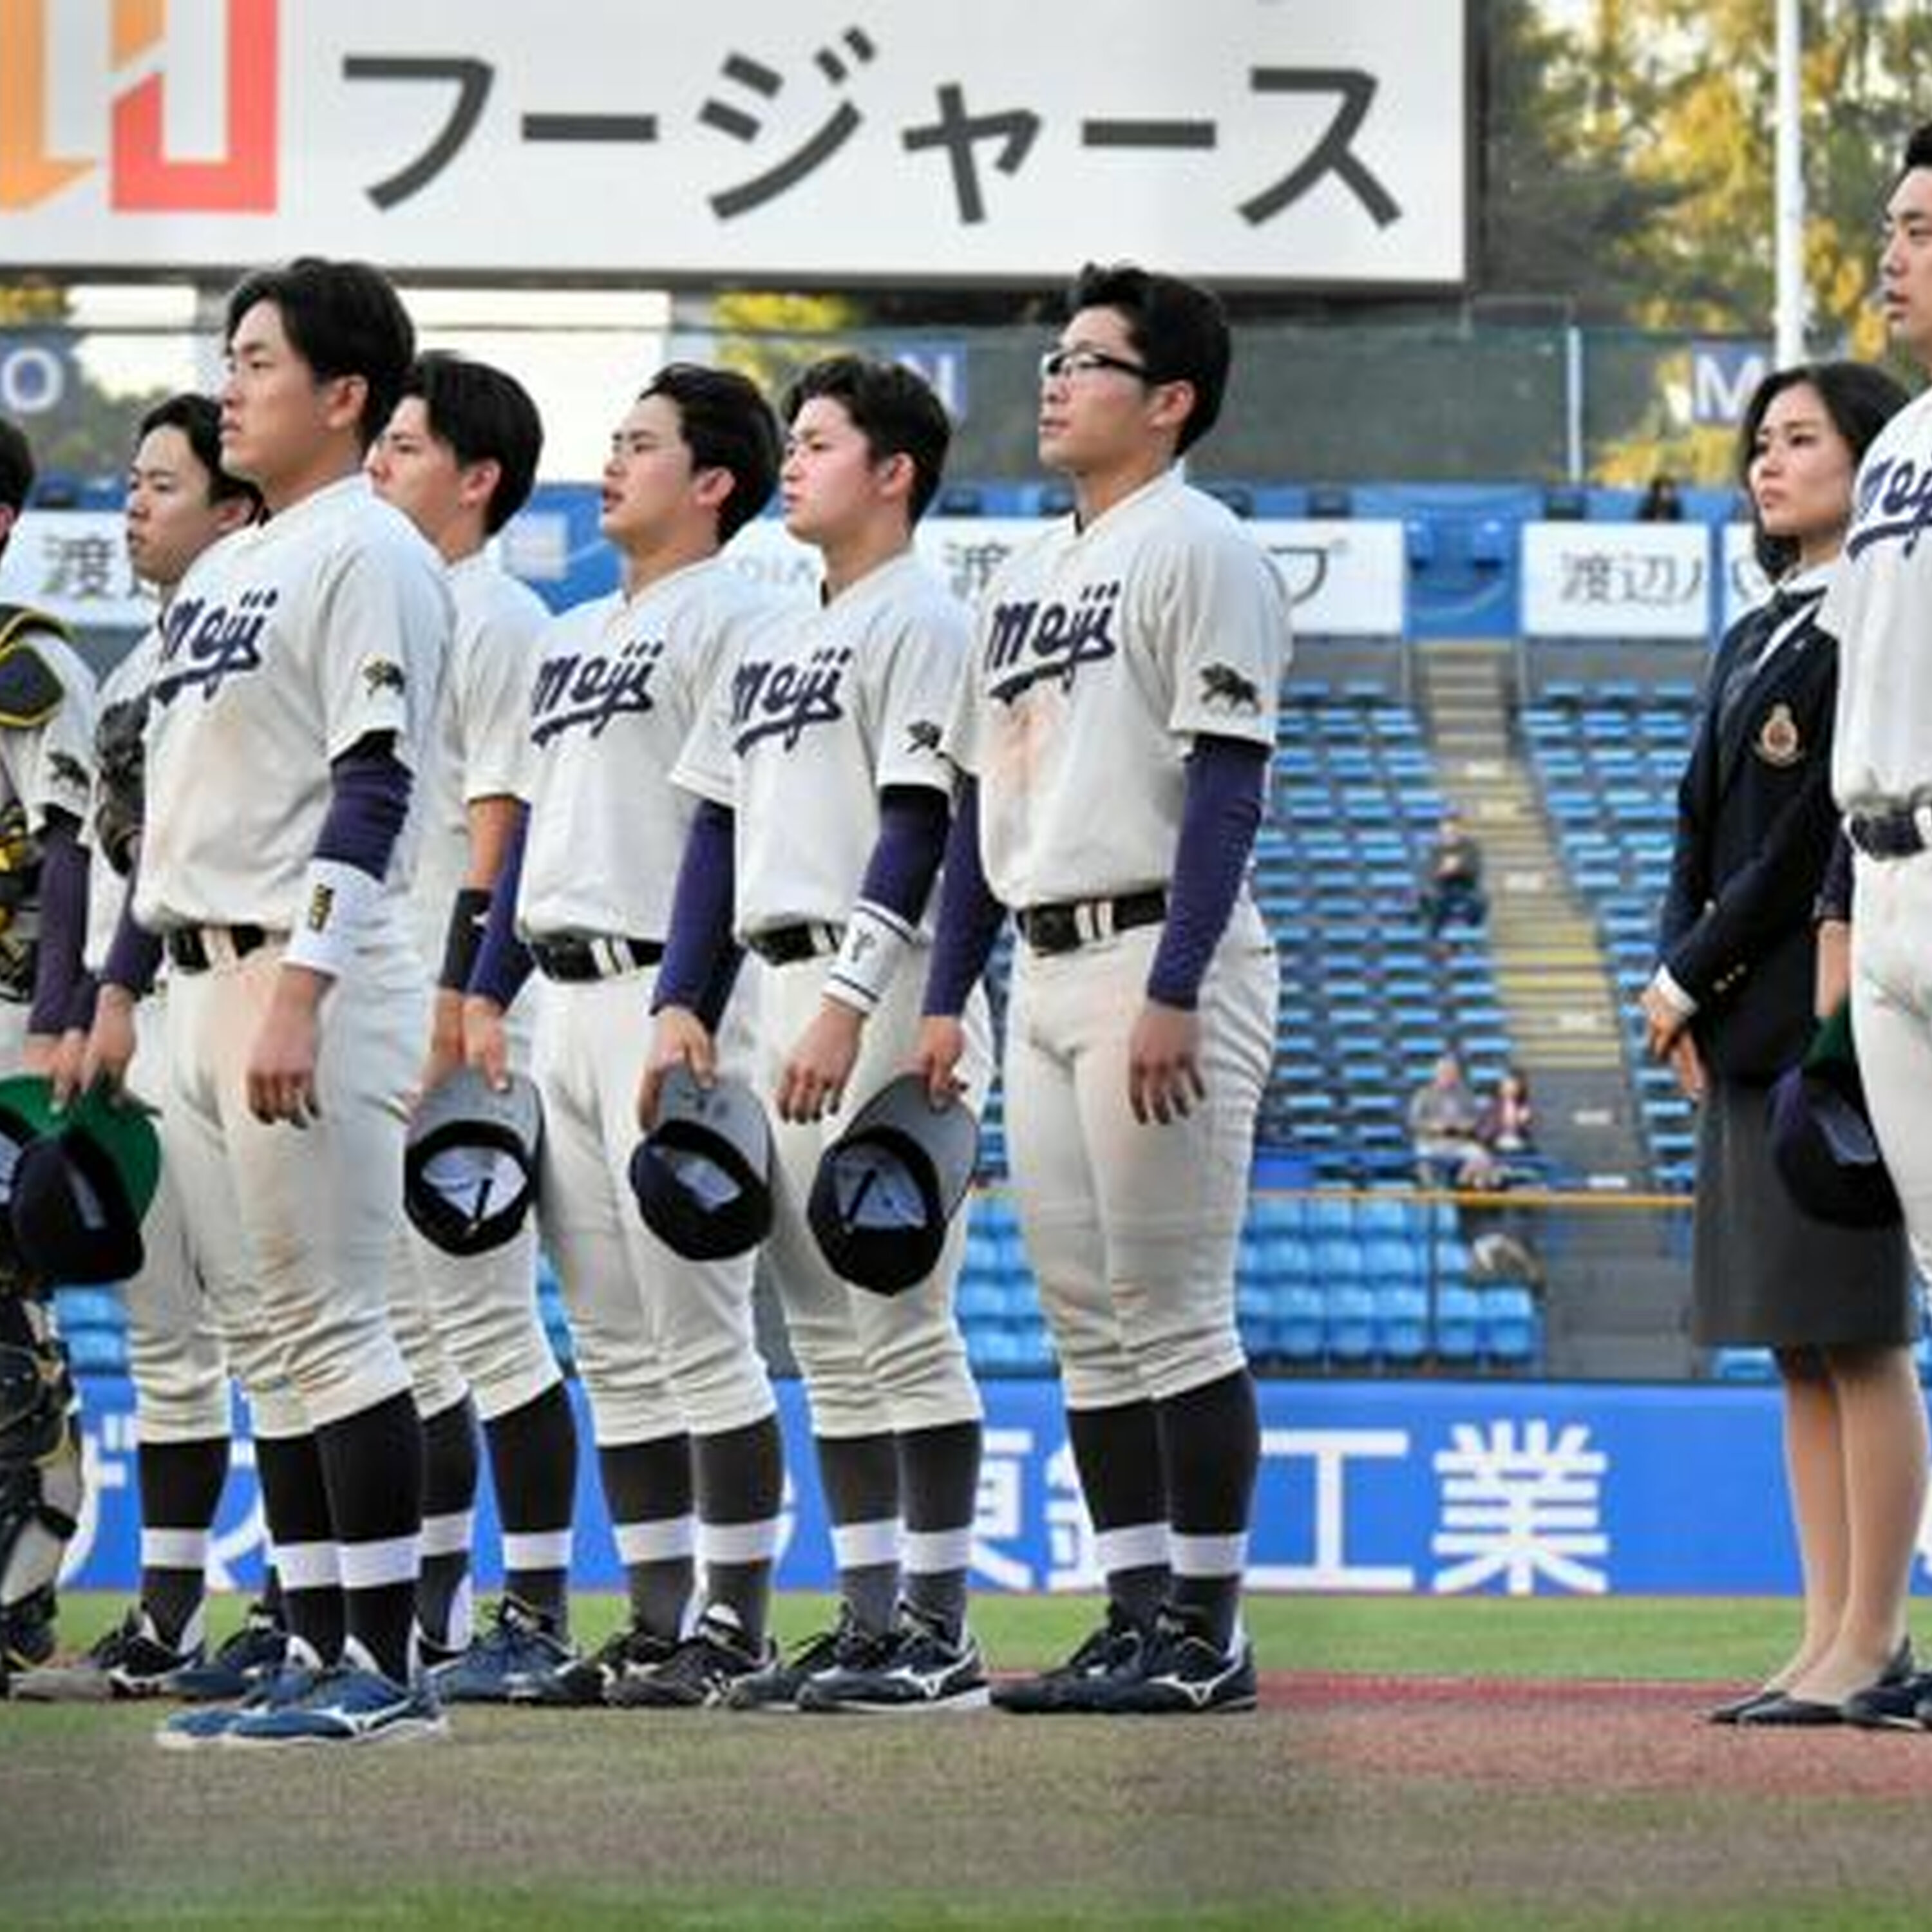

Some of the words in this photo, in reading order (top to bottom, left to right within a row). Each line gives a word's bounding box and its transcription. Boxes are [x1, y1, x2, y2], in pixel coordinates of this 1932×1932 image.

[340, 27, 1404, 227] フージャース
[531, 641, 663, 750] Meiji
[989, 580, 1121, 705] Meiji
[730, 647, 851, 759] Meiji
